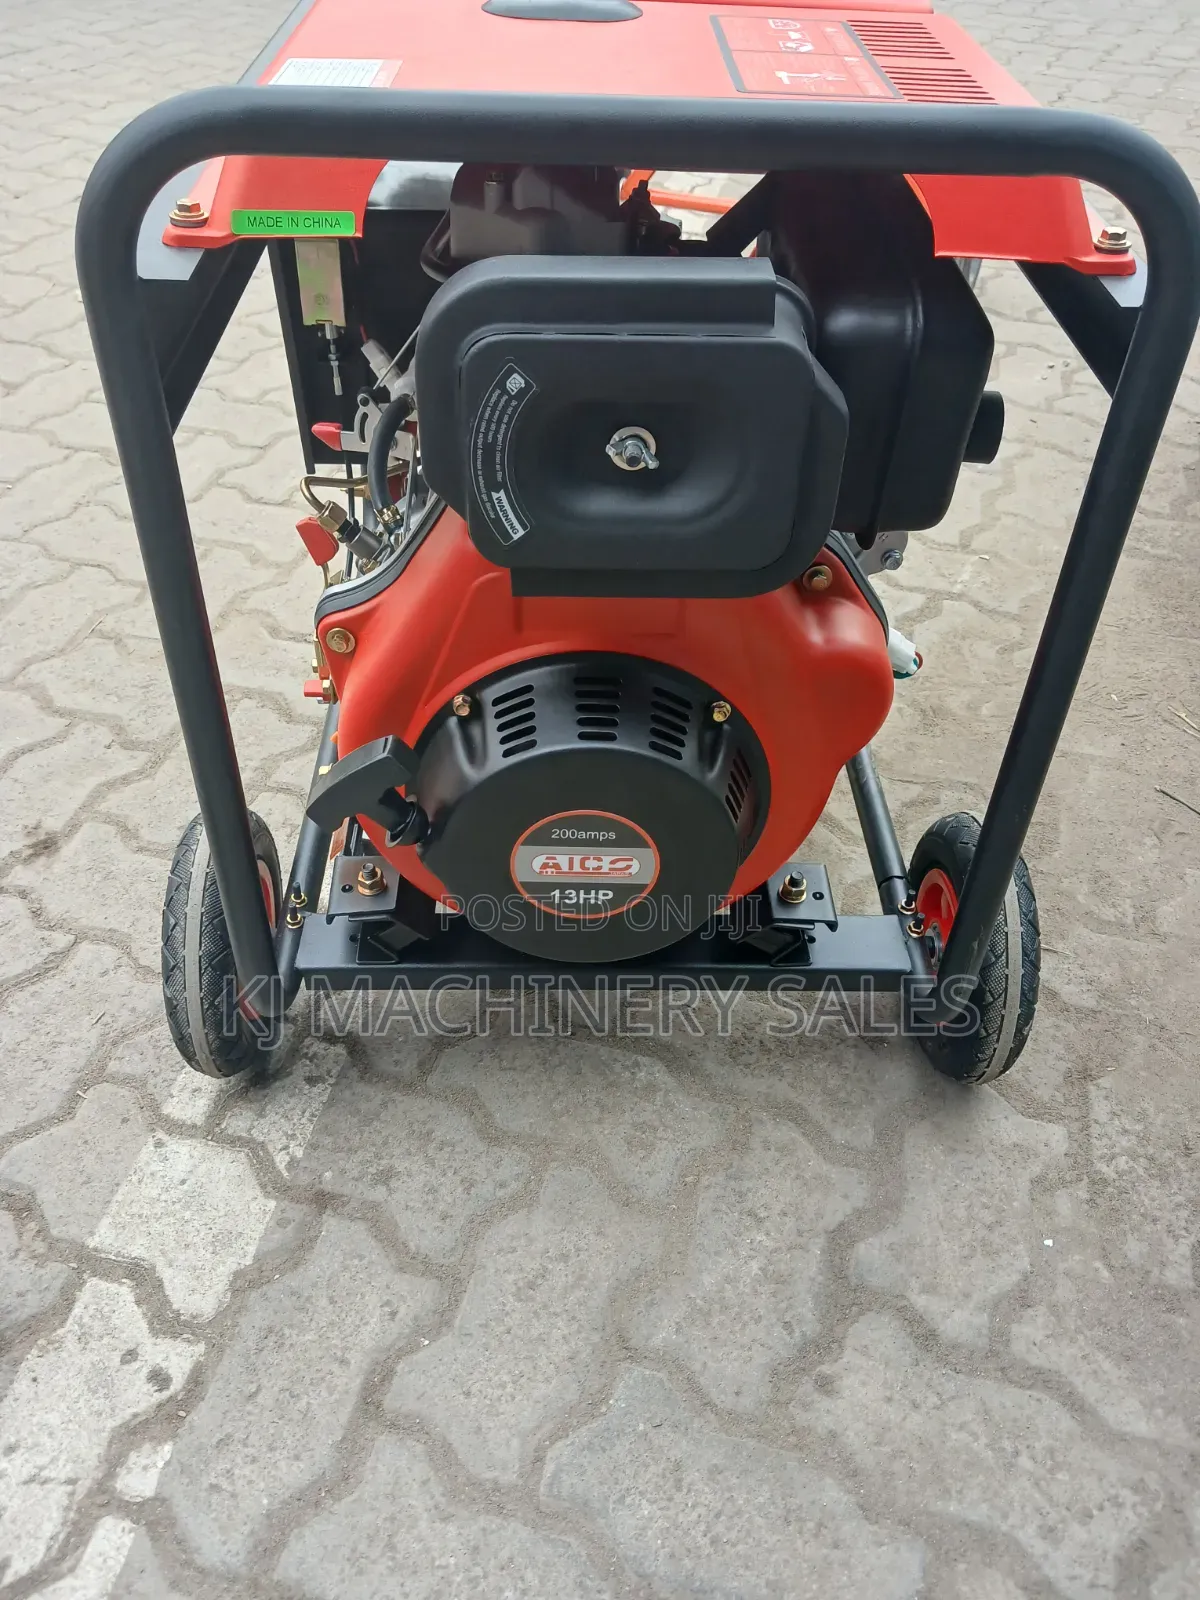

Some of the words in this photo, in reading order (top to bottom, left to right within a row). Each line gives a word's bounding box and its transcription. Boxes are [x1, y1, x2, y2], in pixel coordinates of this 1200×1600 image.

[247, 216, 283, 228] MADE
[287, 217, 299, 228] IN
[303, 217, 341, 228] CHINA
[488, 388, 502, 407] Replace
[495, 496, 519, 535] WARNING
[551, 828, 616, 841] 200amps
[550, 889, 614, 904] 13HP
